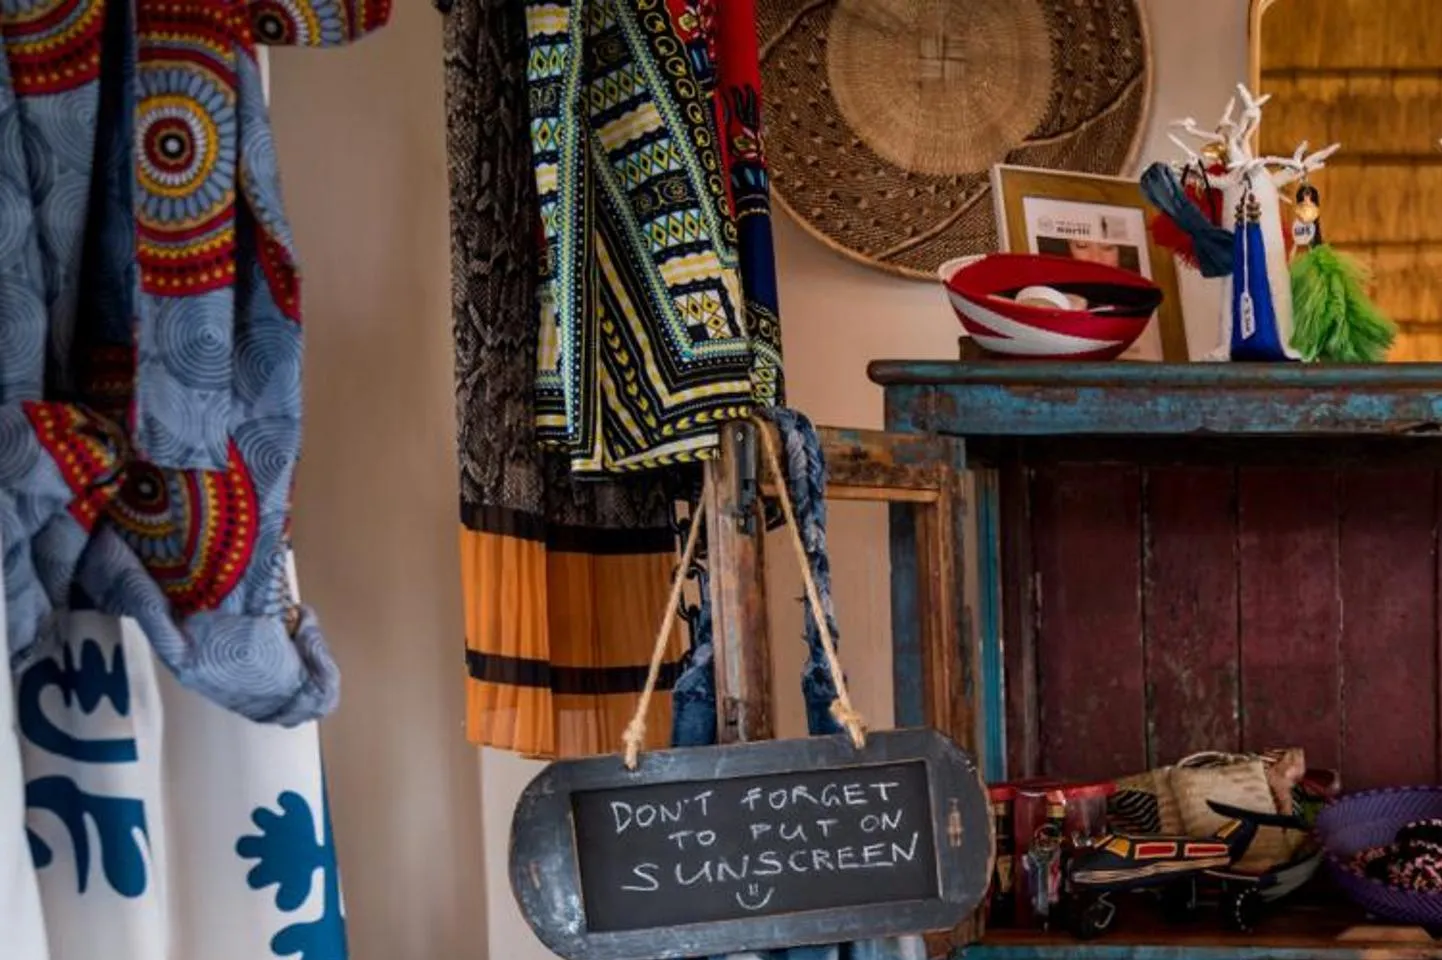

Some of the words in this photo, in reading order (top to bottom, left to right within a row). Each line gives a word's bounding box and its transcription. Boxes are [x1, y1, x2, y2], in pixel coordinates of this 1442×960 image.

[610, 791, 714, 834] DON'T
[740, 782, 899, 812] FORGET
[668, 829, 716, 851] TO
[749, 818, 839, 843] PUT
[860, 808, 903, 834] ON
[621, 831, 919, 893] SUNSCREEN
